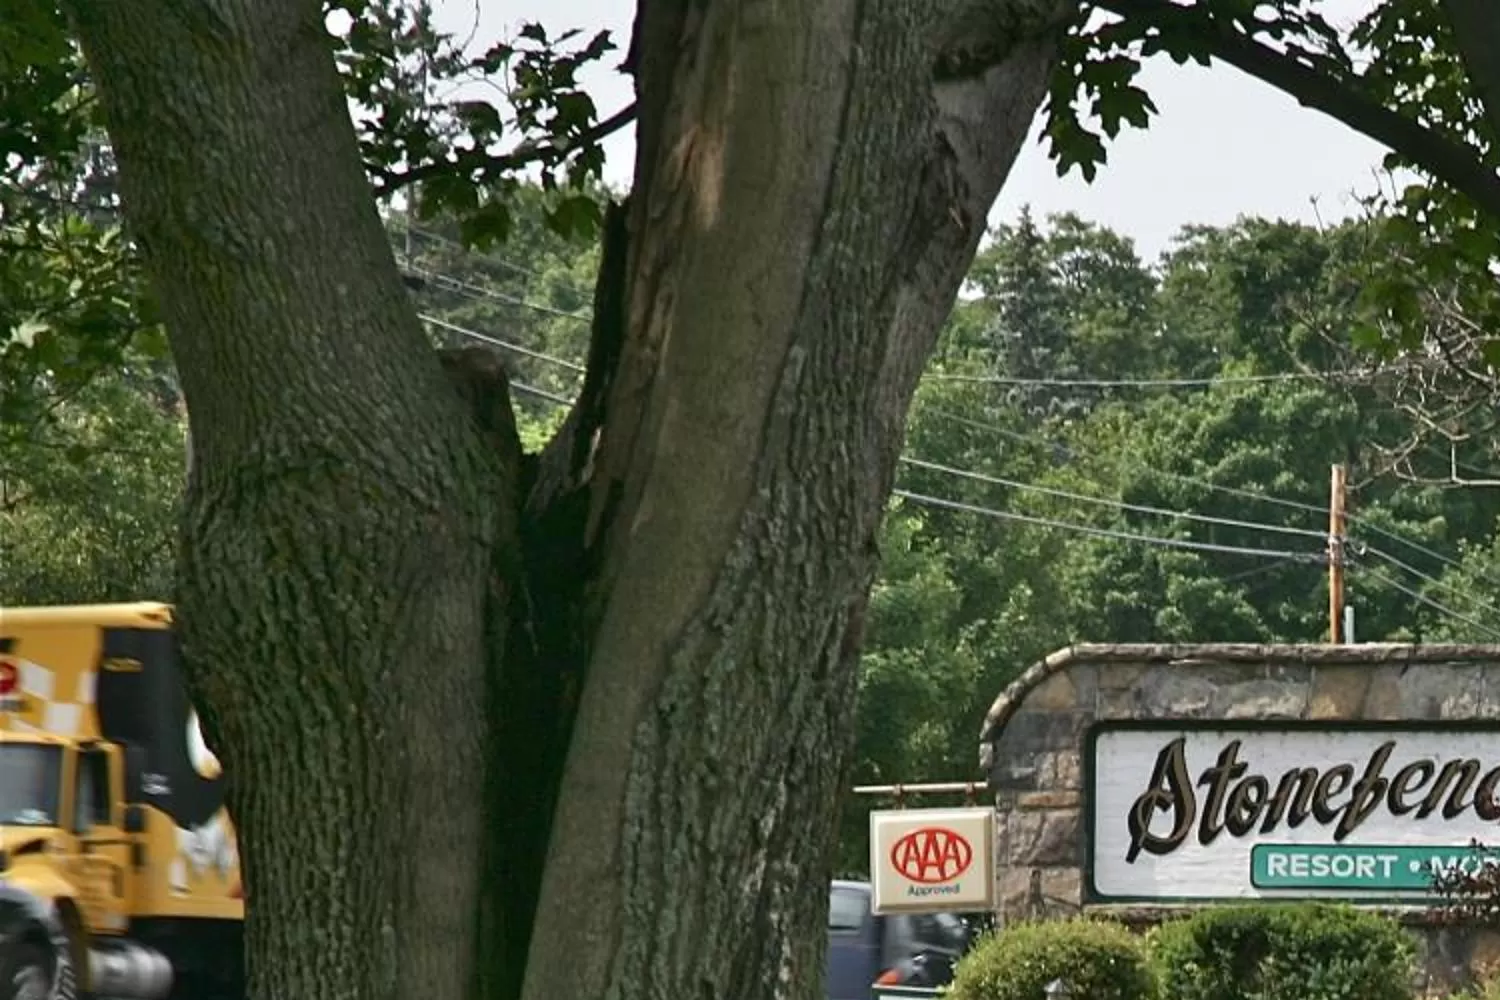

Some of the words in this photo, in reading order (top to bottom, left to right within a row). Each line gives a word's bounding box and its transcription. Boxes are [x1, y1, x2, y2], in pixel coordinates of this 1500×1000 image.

[901, 829, 962, 881] AAA
[1267, 853, 1398, 878] RESORT
[907, 883, 961, 896] Approved
